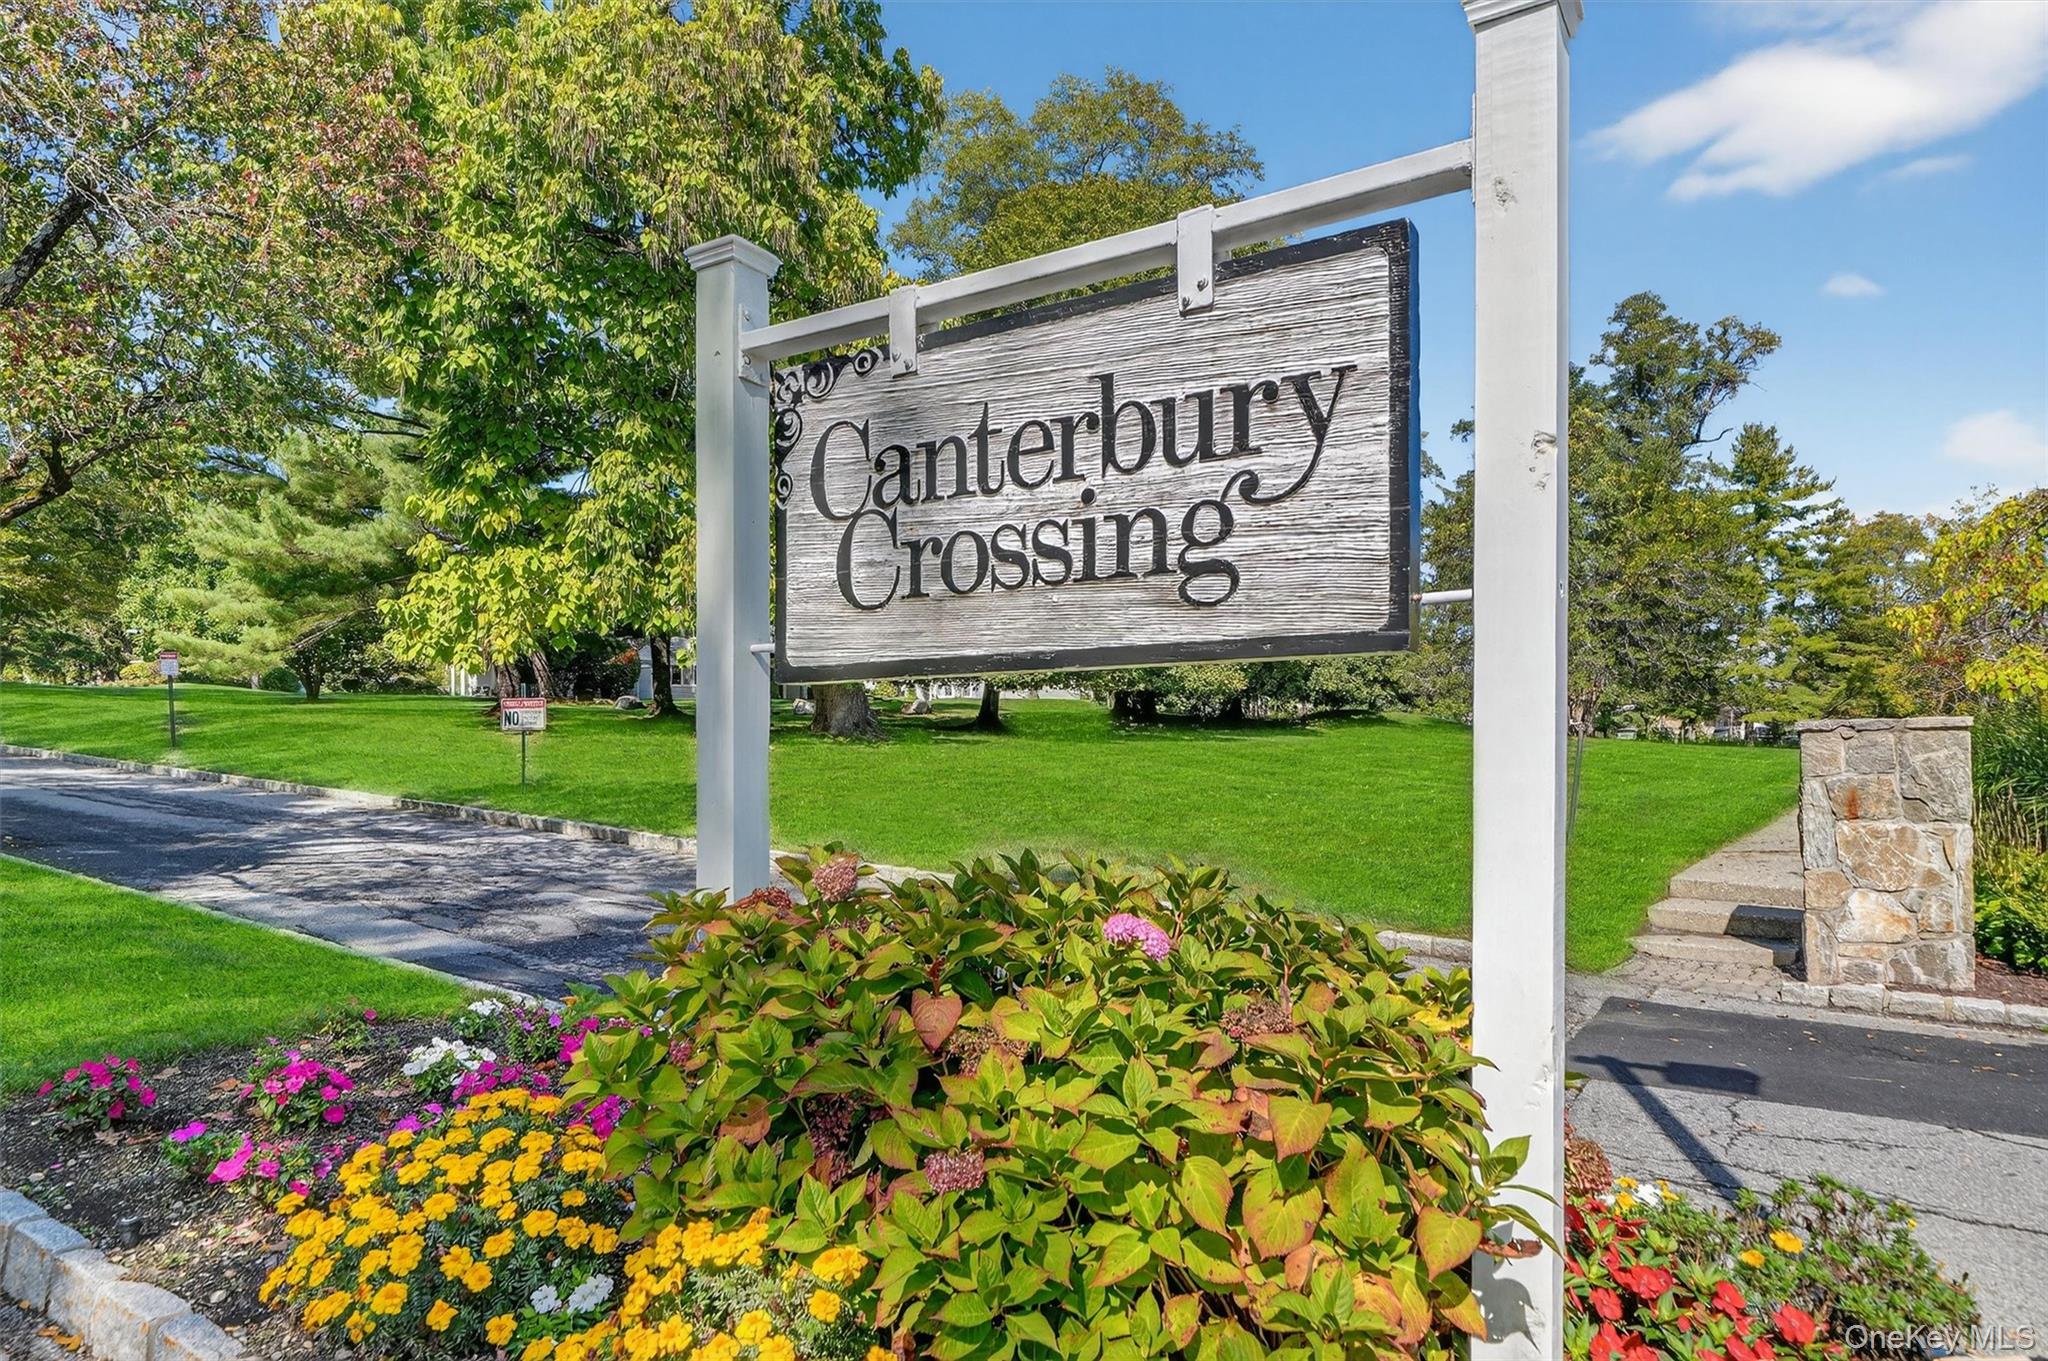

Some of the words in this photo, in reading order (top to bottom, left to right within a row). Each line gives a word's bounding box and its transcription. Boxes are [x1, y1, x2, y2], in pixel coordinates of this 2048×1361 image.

[810, 364, 1357, 520] Canterbury
[836, 488, 1240, 610] Crossing
[504, 710, 519, 726] NO
